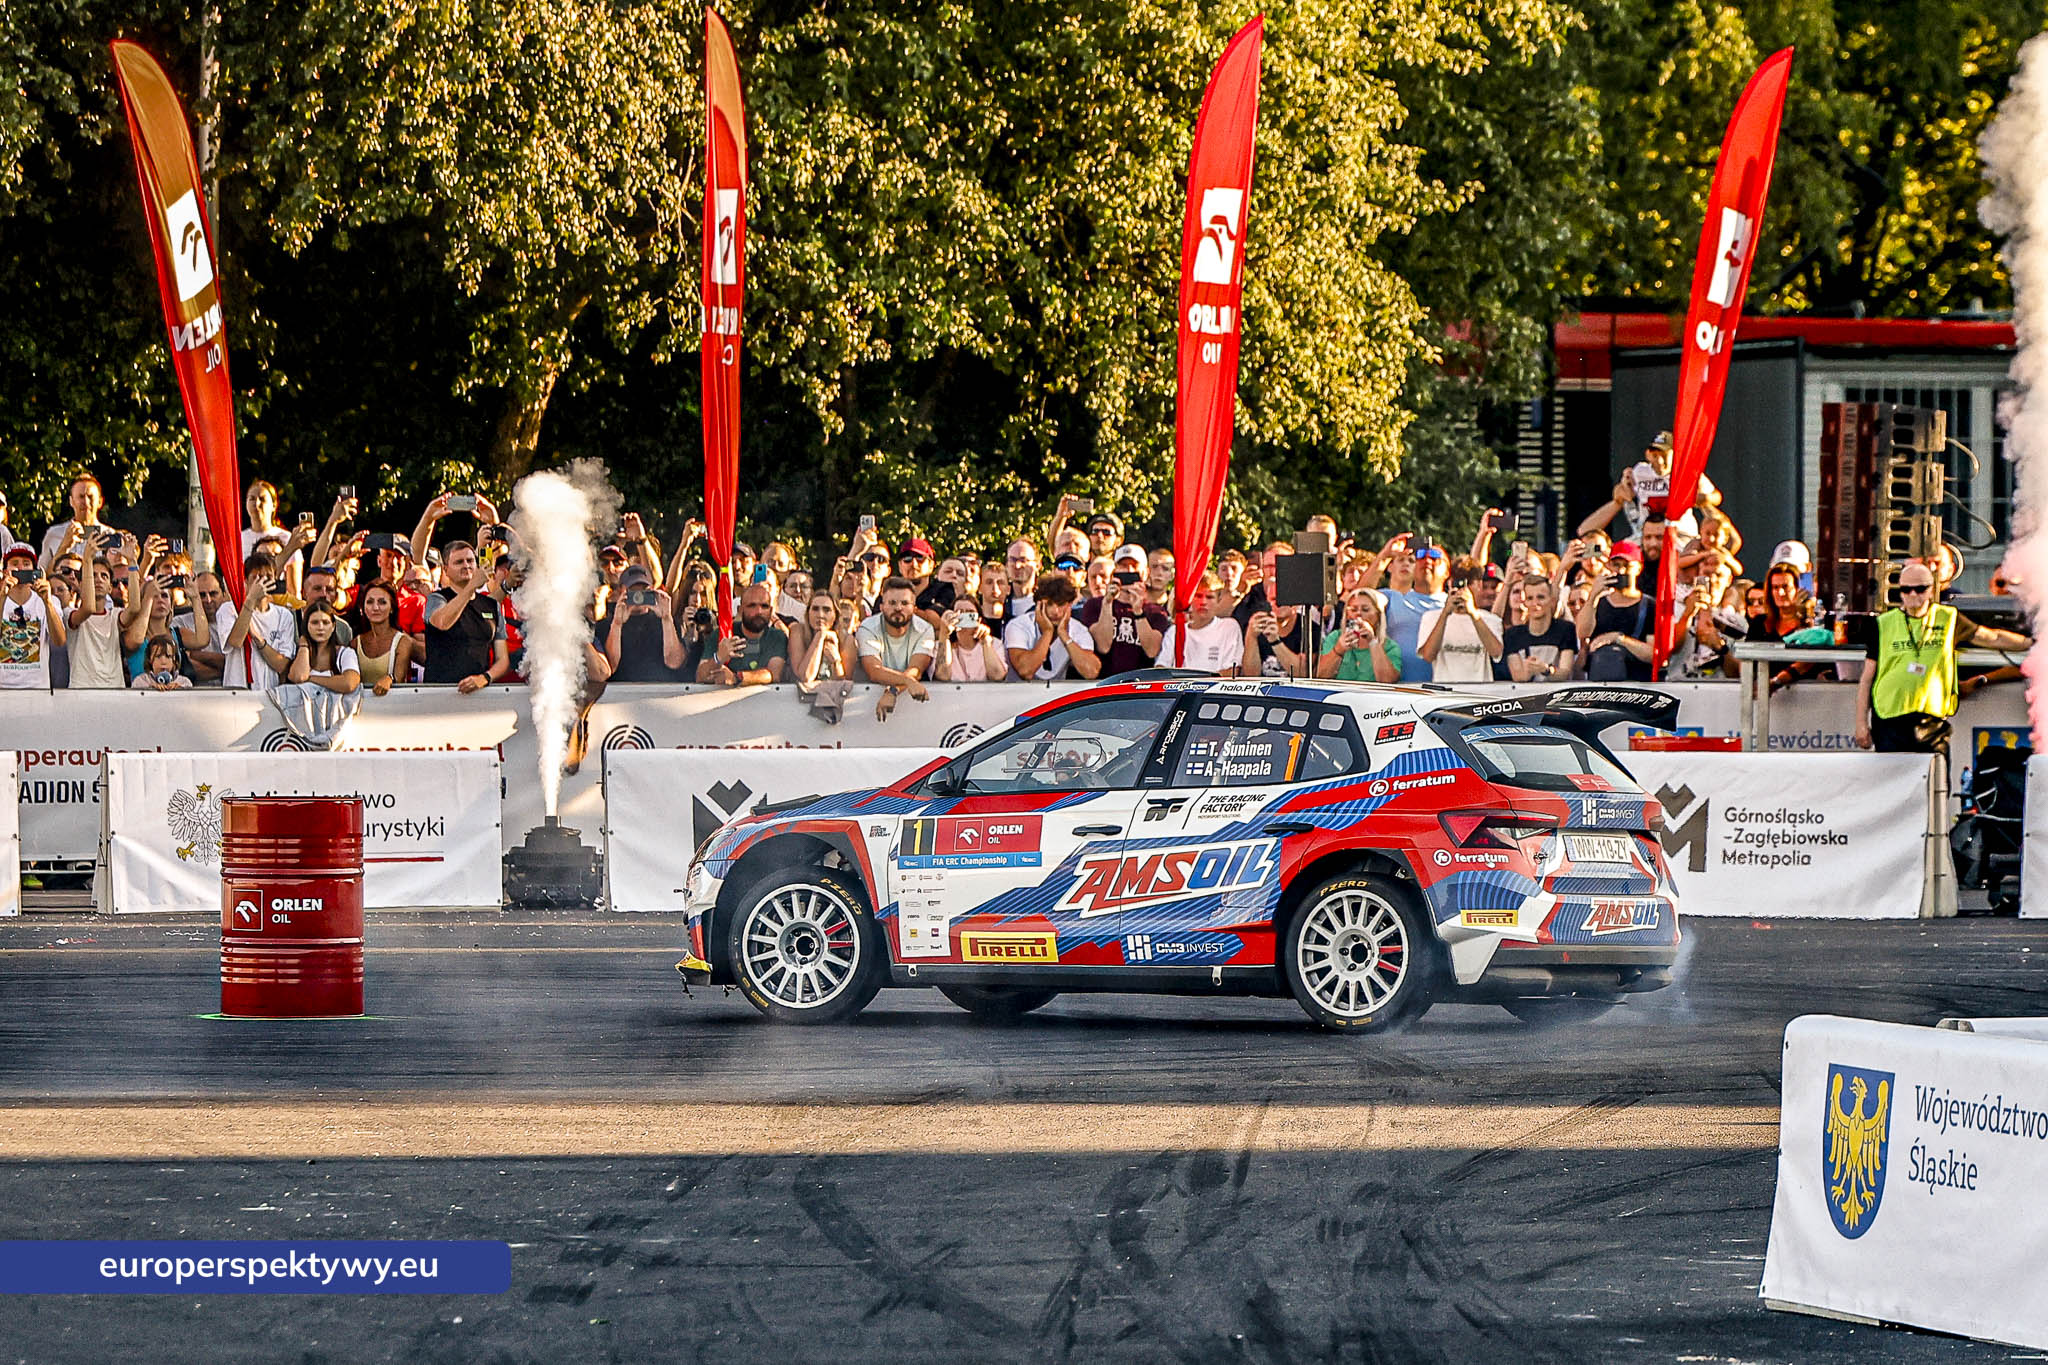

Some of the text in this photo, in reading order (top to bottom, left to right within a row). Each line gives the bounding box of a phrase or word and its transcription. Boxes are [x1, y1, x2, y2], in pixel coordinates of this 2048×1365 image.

[1220, 684, 1257, 692] halo.P1
[1363, 706, 1393, 719] auriol
[1377, 722, 1417, 740] ETS
[1209, 741, 1273, 757] T. Suninen
[1284, 733, 1303, 782] 1
[1203, 760, 1272, 779] A. Haapala
[1392, 774, 1457, 791] ferratum
[1207, 794, 1267, 804] THE RACING
[1200, 803, 1247, 813] FACTORY
[1724, 806, 1825, 828] Górnośląsko
[363, 816, 445, 842] urystyki
[988, 824, 1024, 835] ORLEN
[913, 819, 923, 856] 1
[987, 836, 1001, 844] OIL
[932, 858, 944, 866] FIA
[946, 857, 959, 866] ERC
[961, 854, 1007, 866] Championship
[1454, 852, 1509, 864] ferratum
[1722, 848, 1812, 869] Metropolia
[1065, 843, 1271, 912] AMSOIL
[271, 898, 323, 911] ORLEN
[271, 913, 291, 924] OIL
[1466, 912, 1513, 924] PIRELLI
[1587, 900, 1658, 932] AMSOIL
[969, 937, 1047, 957] PIRELLI
[1186, 942, 1225, 953] INVEST
[1915, 1084, 2048, 1140] Województwo
[1908, 1136, 1978, 1195] Śląskie
